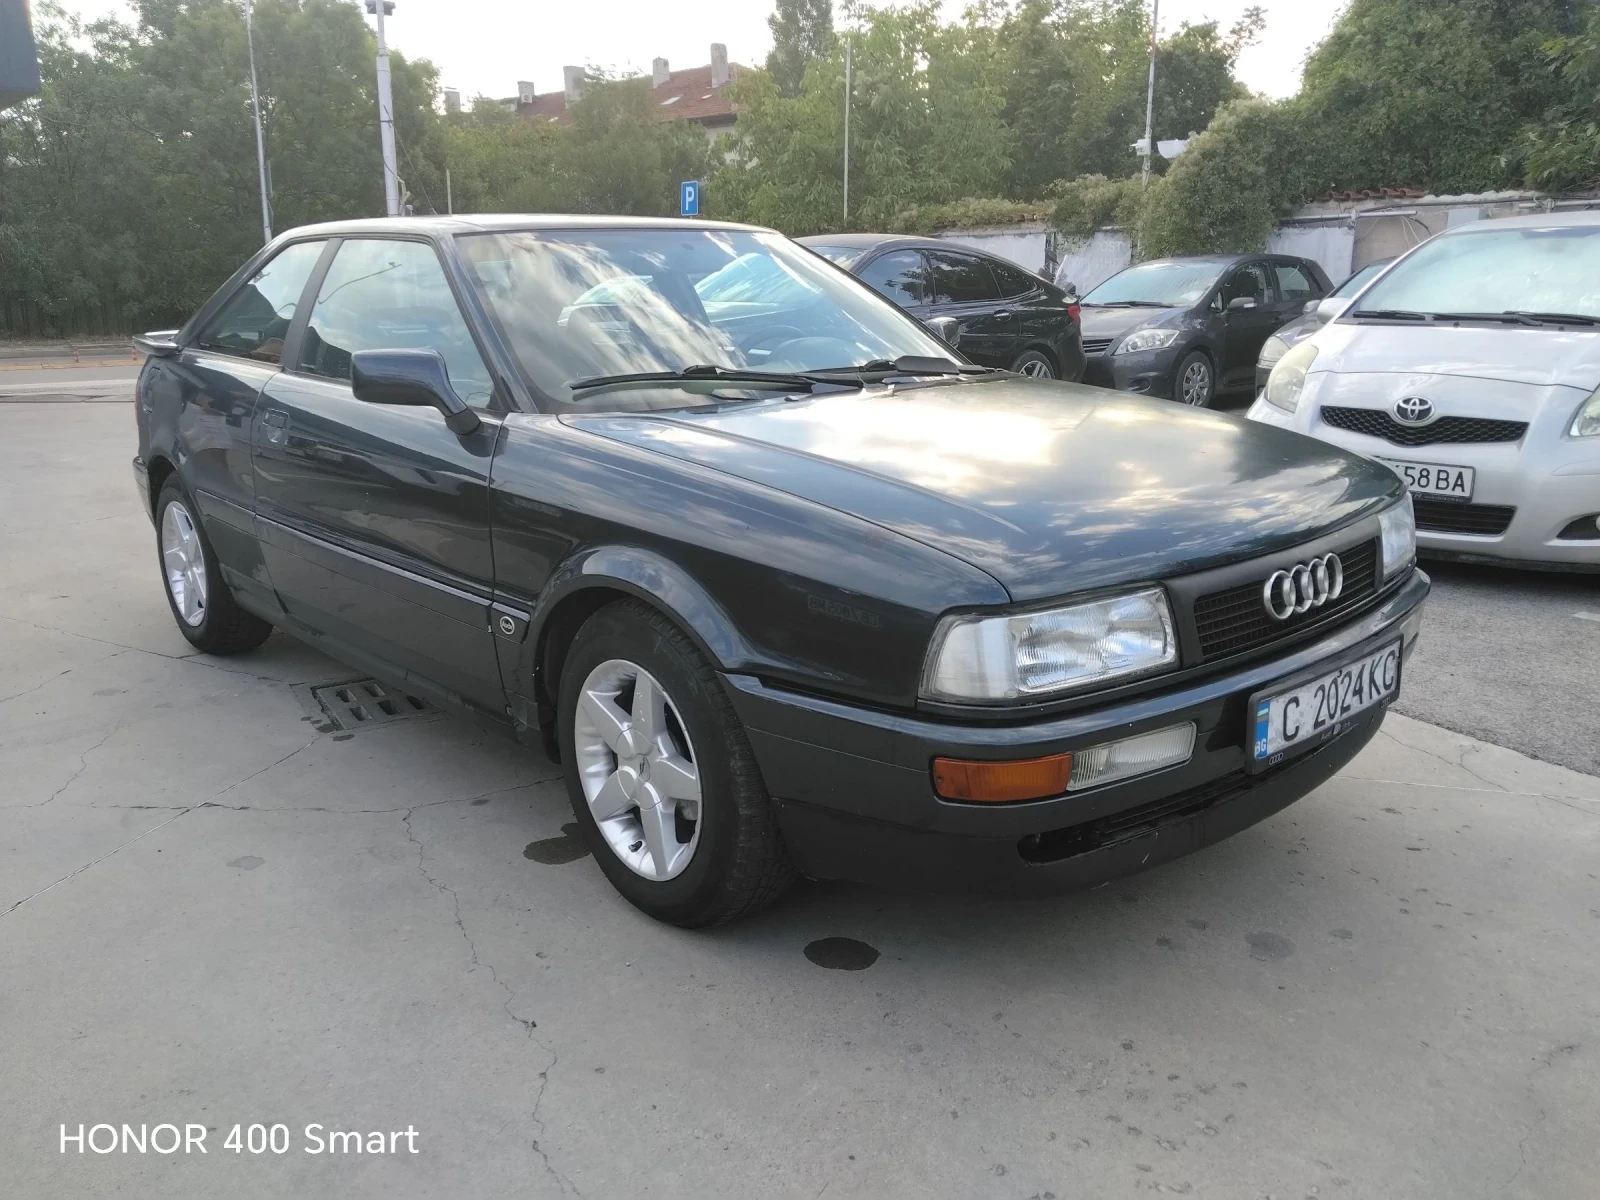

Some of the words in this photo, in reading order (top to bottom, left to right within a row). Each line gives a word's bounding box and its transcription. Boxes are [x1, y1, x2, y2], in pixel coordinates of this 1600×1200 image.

[685, 186, 695, 211] P
[1396, 464, 1430, 488] 58
[1435, 469, 1465, 492] BA
[1283, 696, 1300, 742] C
[1313, 663, 1366, 730] 2024
[1368, 649, 1396, 700] KC
[1254, 738, 1267, 758] BG
